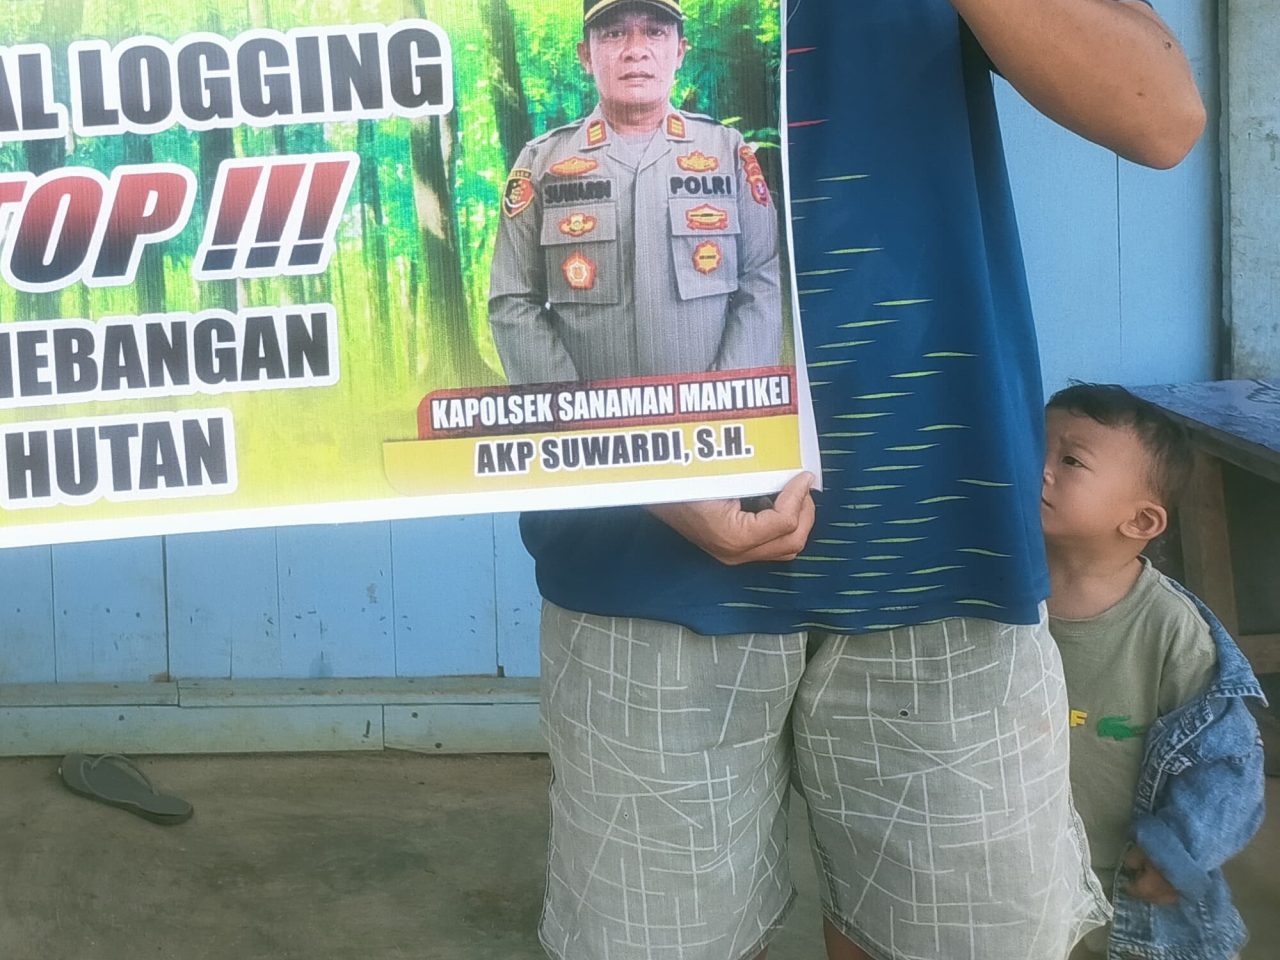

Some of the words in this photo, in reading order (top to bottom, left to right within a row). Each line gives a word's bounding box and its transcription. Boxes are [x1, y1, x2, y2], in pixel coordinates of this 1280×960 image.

[77, 27, 444, 127] LOGGING
[201, 159, 352, 272] !!!
[670, 175, 732, 196] POLRI
[431, 393, 555, 430] KAPOLSEK
[558, 384, 673, 421] SANAMAN
[679, 375, 790, 413] MANTIKEI
[4, 416, 229, 500] HUTAN
[476, 442, 535, 474] AKP
[542, 431, 690, 470] SUWARDI,
[697, 426, 751, 457] S.H.
